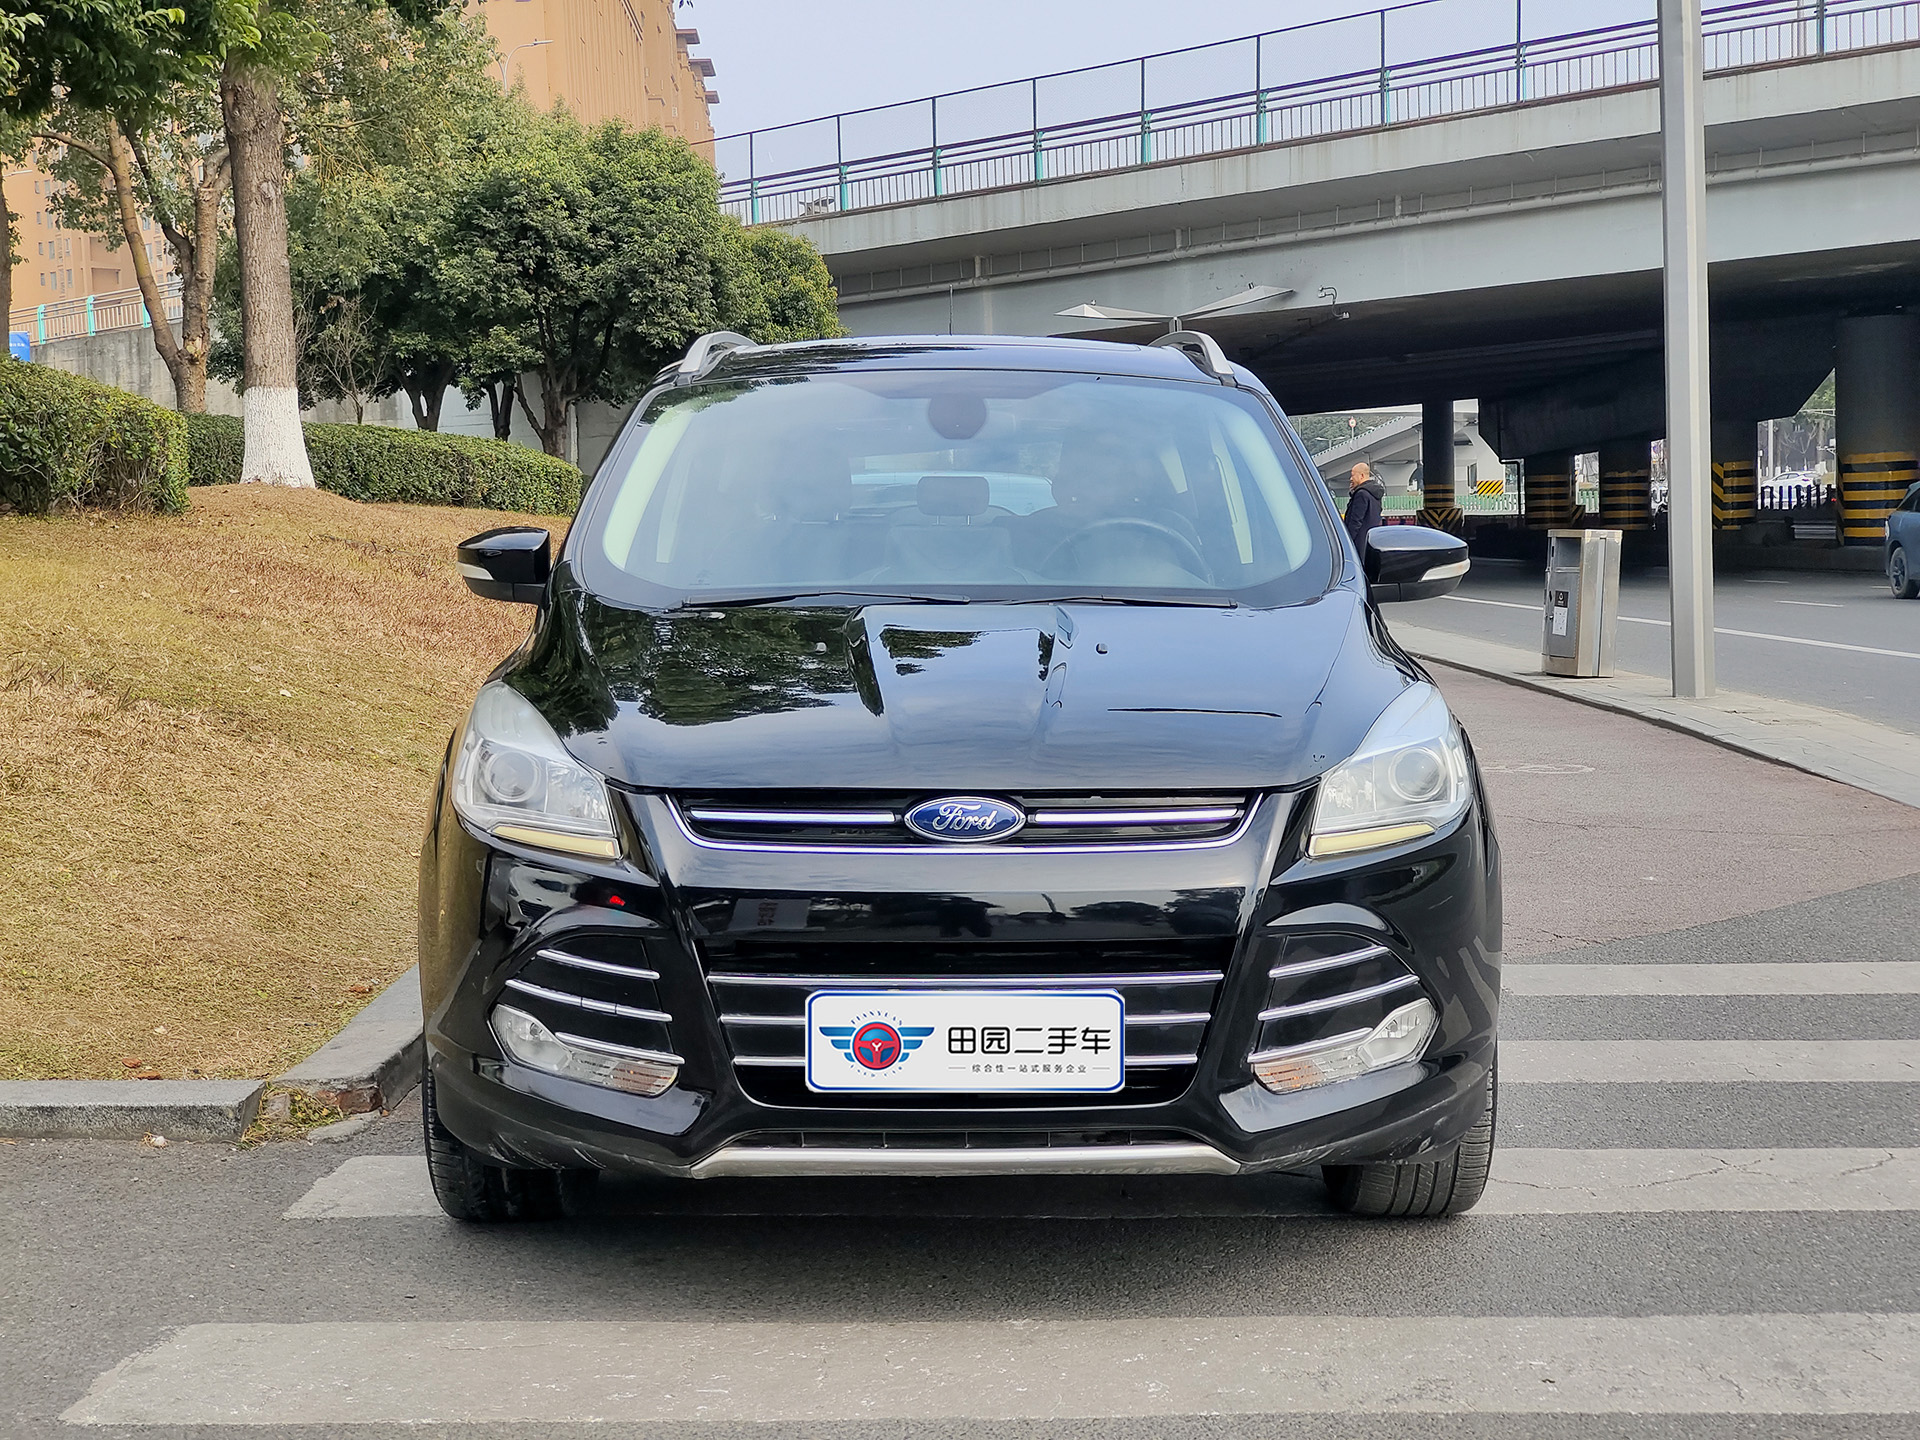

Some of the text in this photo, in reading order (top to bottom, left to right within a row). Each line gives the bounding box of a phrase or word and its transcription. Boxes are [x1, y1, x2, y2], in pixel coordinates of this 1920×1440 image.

[932, 802, 998, 831] Ford
[948, 1026, 1112, 1055] 田园二手车
[972, 1063, 1087, 1074] 综合性一站式服务企业
